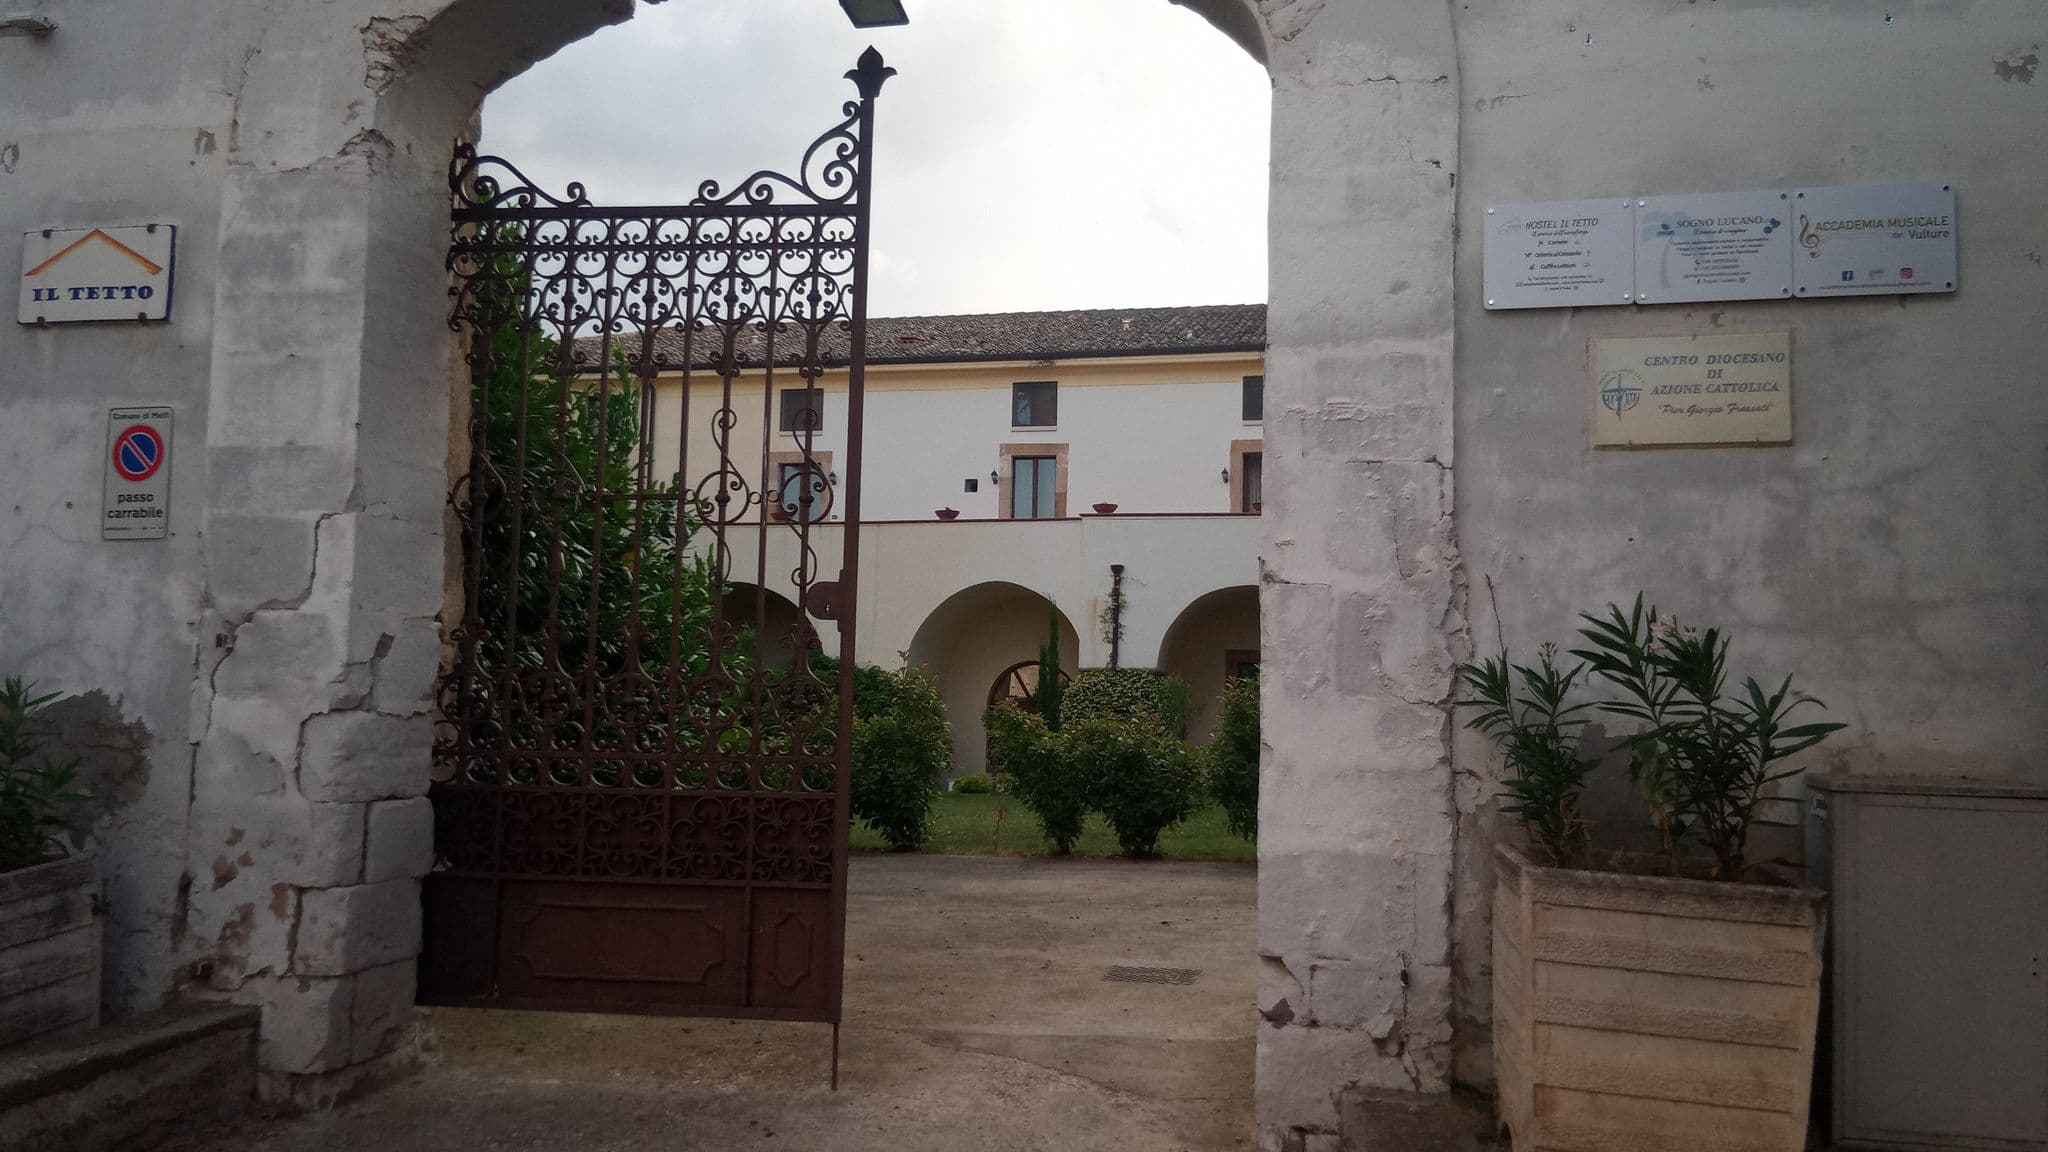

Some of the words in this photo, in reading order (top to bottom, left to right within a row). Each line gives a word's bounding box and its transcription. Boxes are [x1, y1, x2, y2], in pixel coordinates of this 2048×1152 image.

[1525, 220, 1558, 230] HOSTEL
[1560, 219, 1570, 228] IL
[1572, 218, 1599, 227] TETTO
[1676, 218, 1714, 228] SOGNO
[1717, 216, 1763, 226] LUCANO
[1815, 219, 1884, 232] ACCADEMIA
[1887, 216, 1950, 228] MUSICALE
[1908, 229, 1950, 239] Vulture
[32, 287, 60, 302] IL
[68, 285, 154, 301] TETTO
[1644, 355, 1698, 367] CENTRO
[1706, 352, 1786, 365] DIOCESANO
[1706, 368, 1724, 379] DI
[1650, 383, 1703, 396] AZIONE
[1705, 382, 1780, 395] CATTOLICA
[117, 493, 154, 505] passo
[107, 506, 164, 519] carrabile
